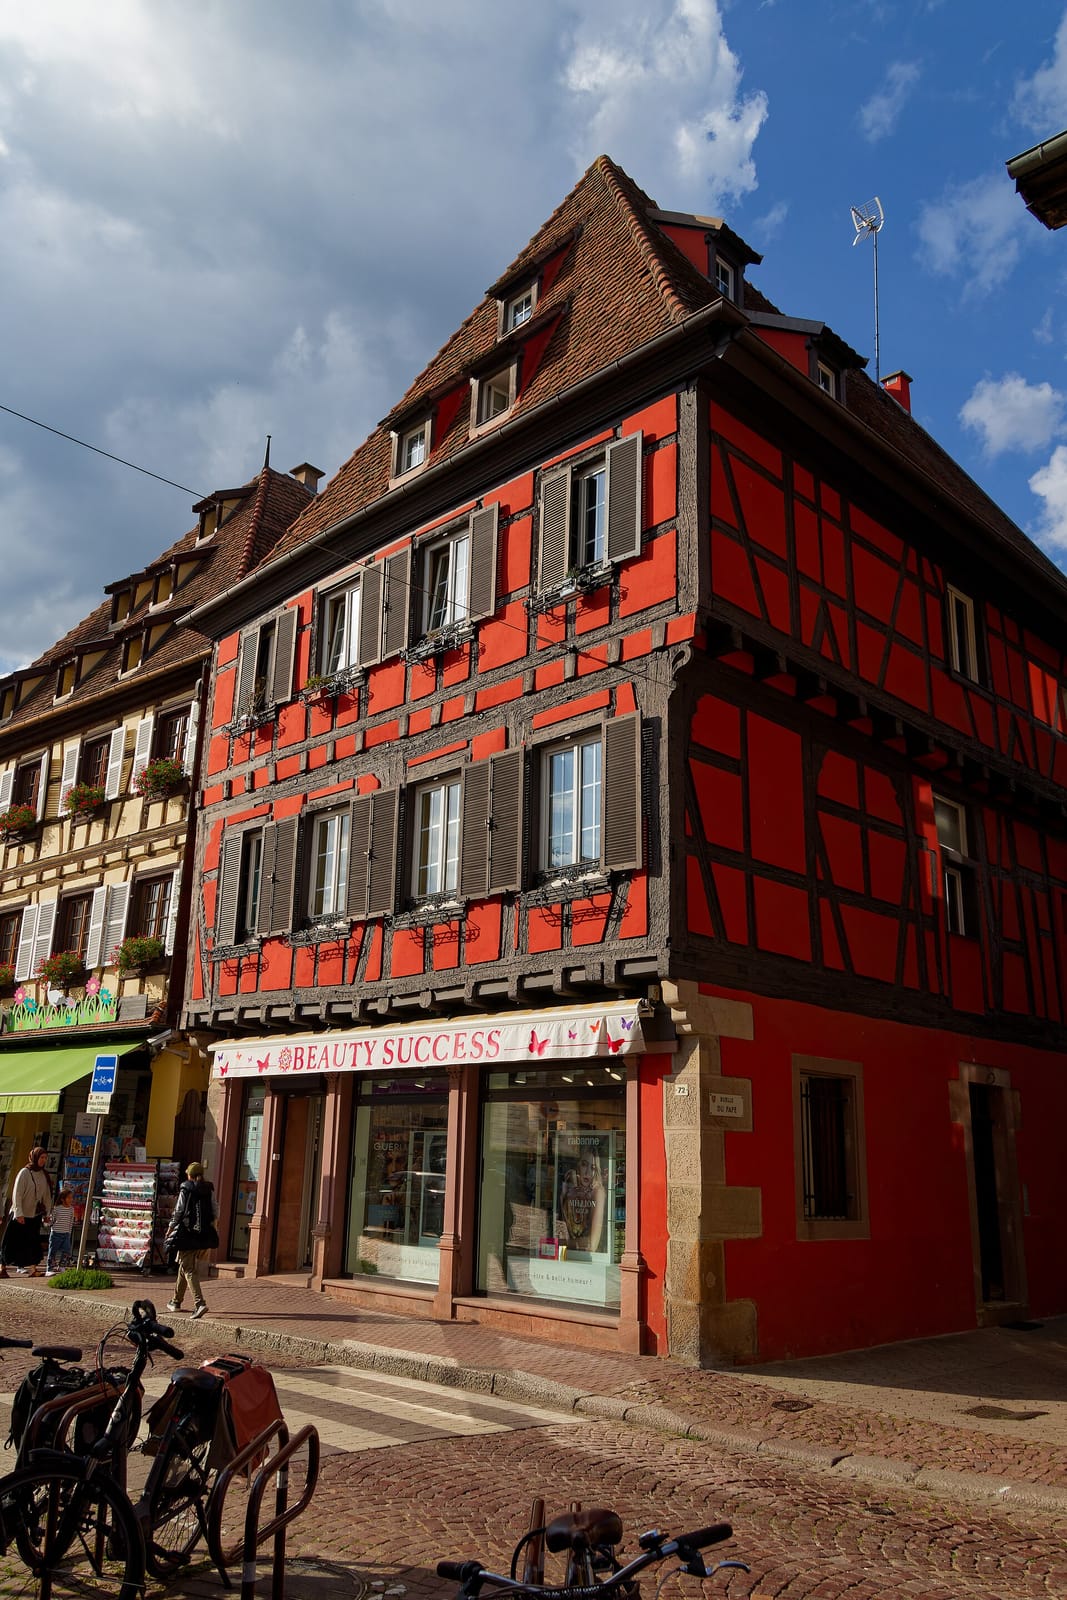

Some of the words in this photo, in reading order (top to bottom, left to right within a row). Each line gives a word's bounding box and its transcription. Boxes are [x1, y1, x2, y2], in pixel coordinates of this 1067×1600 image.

[292, 1040, 377, 1070] BEAUTY
[382, 1029, 501, 1066] SUCCESS
[677, 1086, 686, 1094] 72
[567, 1136, 600, 1146] rabanne
[569, 1199, 597, 1208] MILLION
